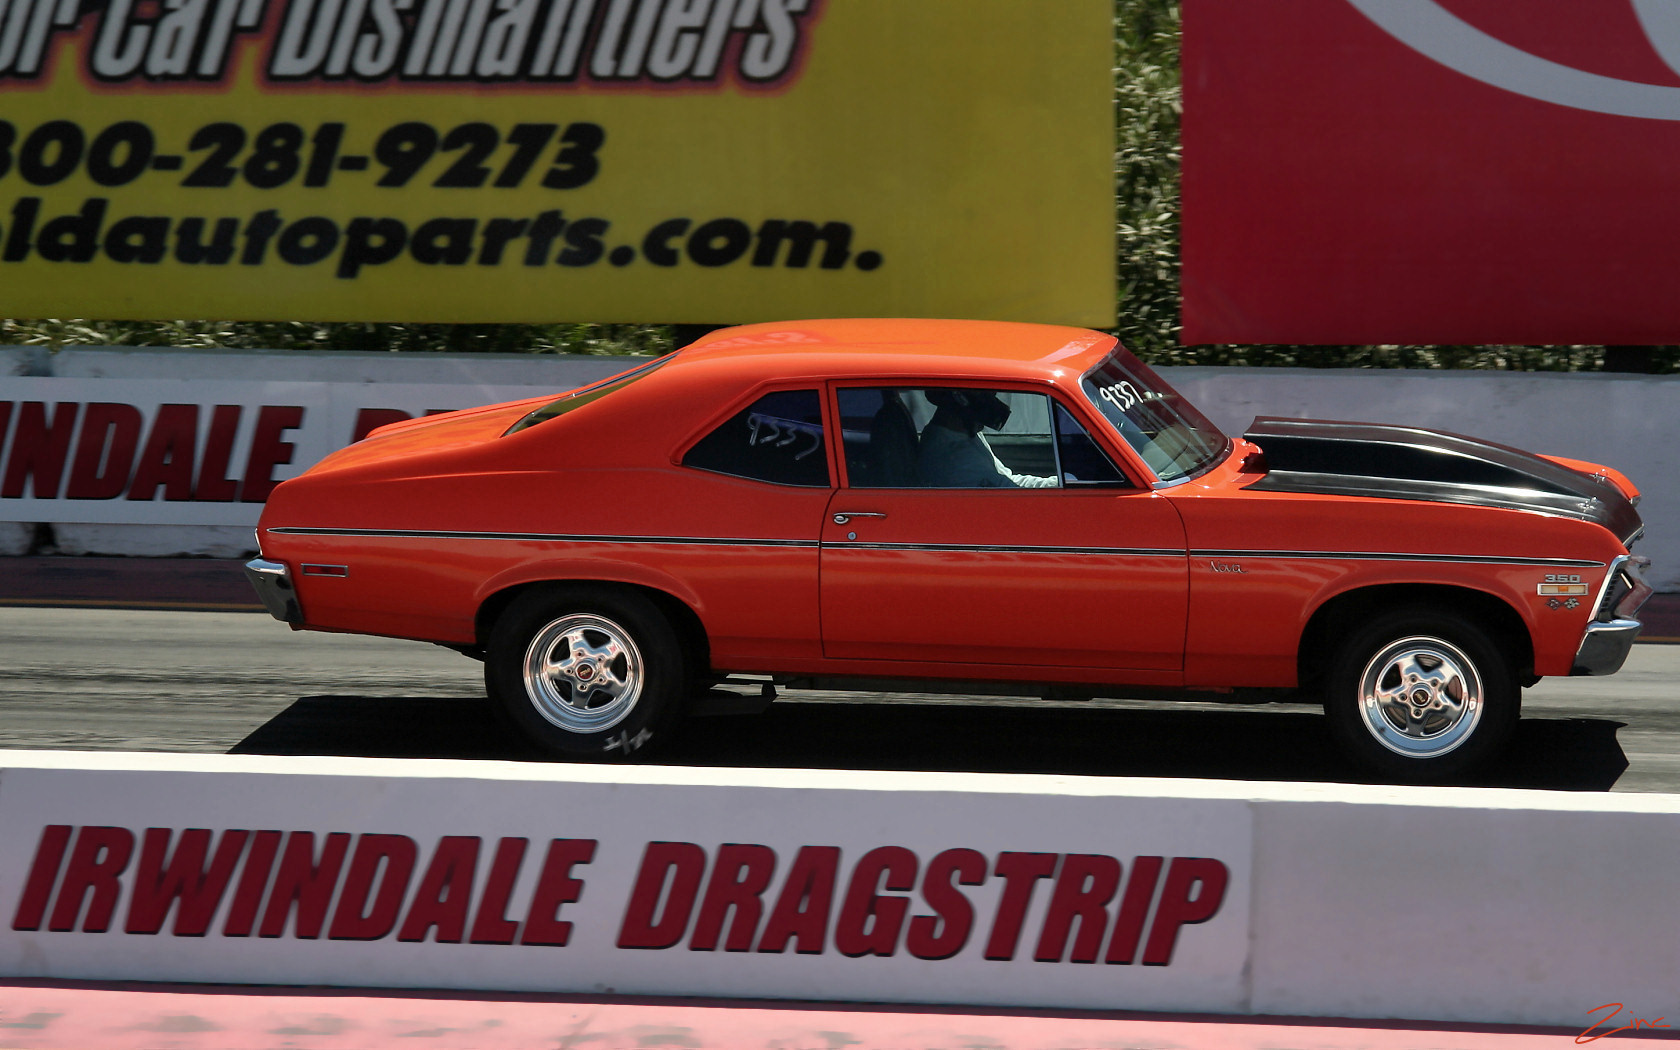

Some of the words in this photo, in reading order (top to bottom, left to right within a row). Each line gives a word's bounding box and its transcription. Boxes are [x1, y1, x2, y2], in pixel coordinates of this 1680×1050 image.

[0, 197, 882, 279] ldautoparts.com.
[1100, 381, 1143, 412] 9337
[0, 402, 305, 503] NDALE
[1544, 574, 1580, 583] 350
[12, 825, 597, 947] IRWINDALE
[616, 841, 1229, 967] DRAGSTRIP
